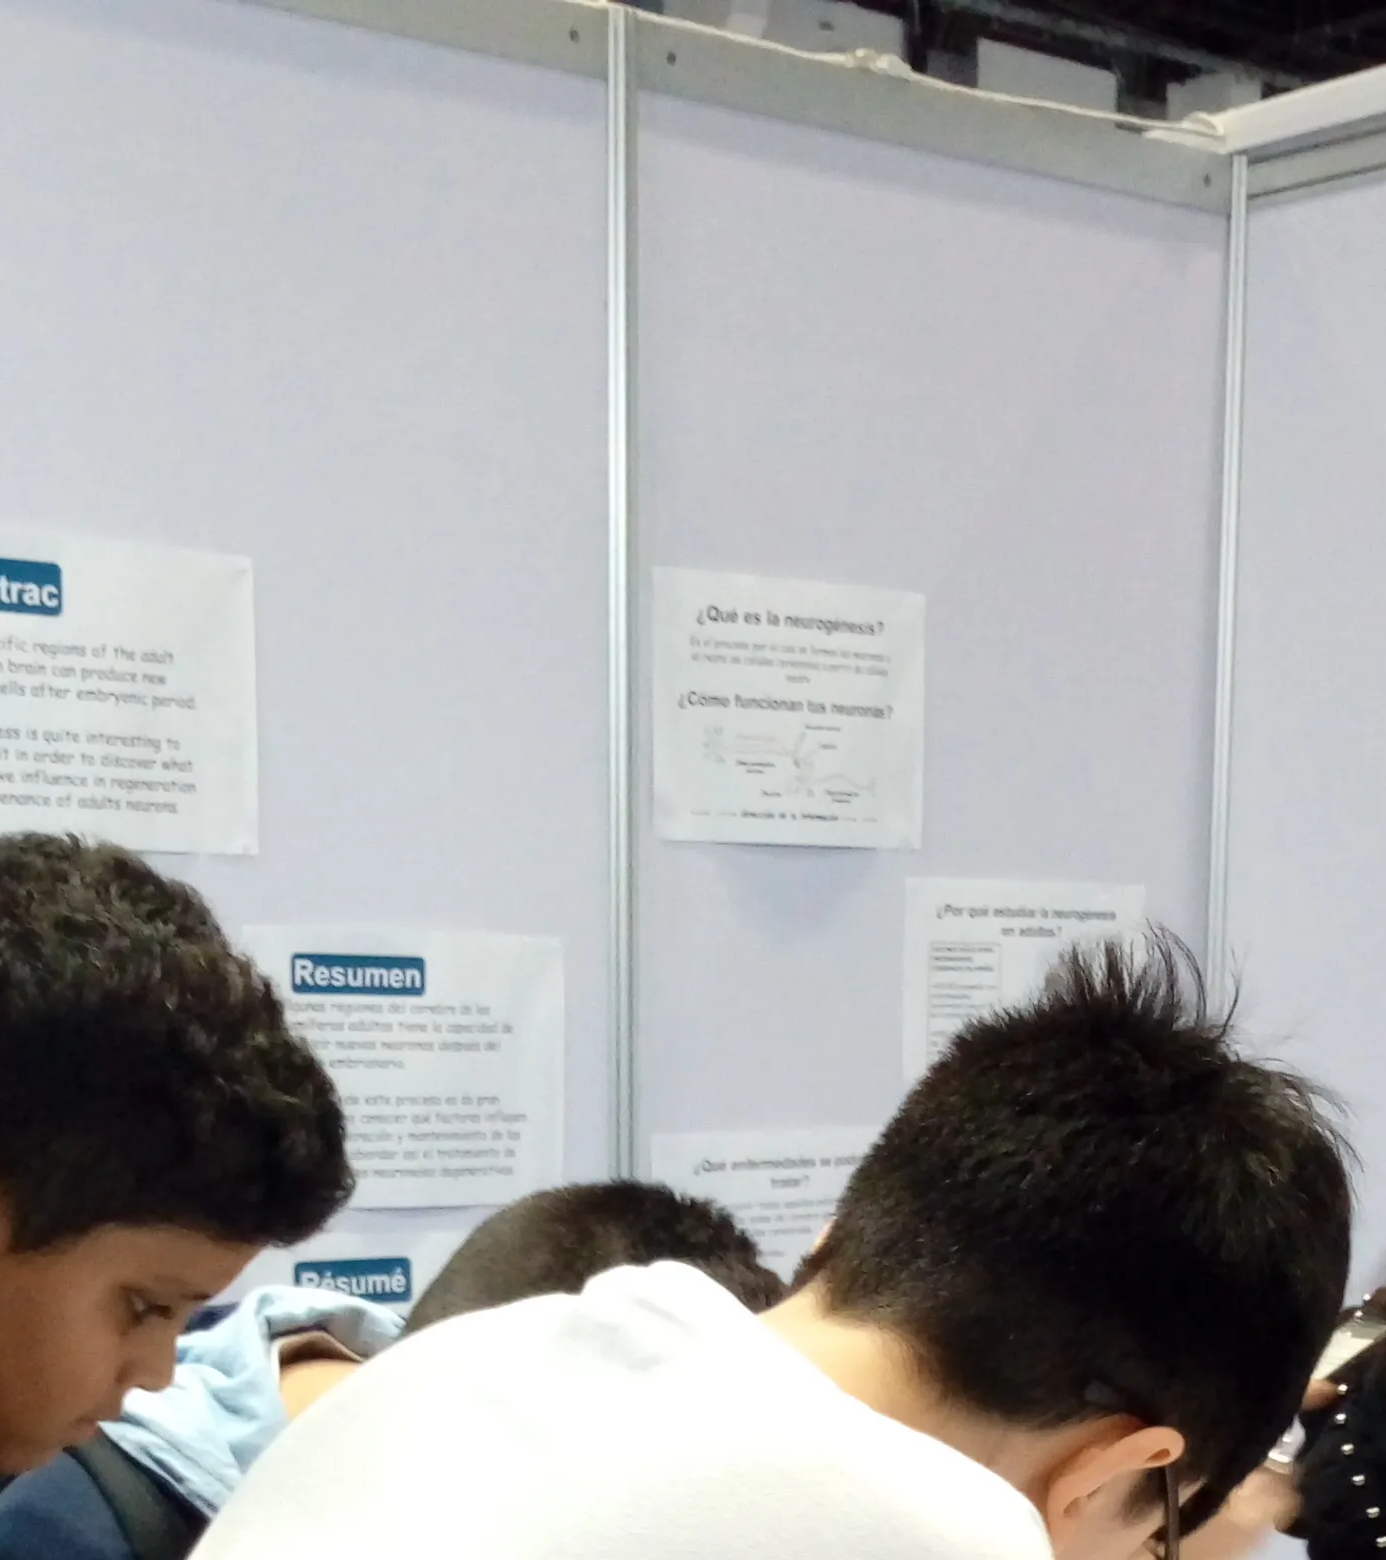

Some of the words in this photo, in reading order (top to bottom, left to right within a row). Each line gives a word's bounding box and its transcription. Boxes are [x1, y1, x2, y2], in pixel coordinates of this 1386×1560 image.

[744, 611, 761, 623] es
[767, 610, 780, 627] la
[33, 642, 86, 659] regions
[92, 644, 106, 658] of
[114, 647, 136, 662] the
[8, 659, 46, 675] brain
[51, 665, 76, 677] can
[26, 728, 37, 741] is
[43, 730, 80, 743] quite
[15, 749, 28, 761] in
[33, 750, 74, 764] order
[81, 753, 95, 766] to
[56, 795, 71, 808] of
[294, 959, 422, 989] Resumen
[300, 1266, 407, 1296] Résumé
